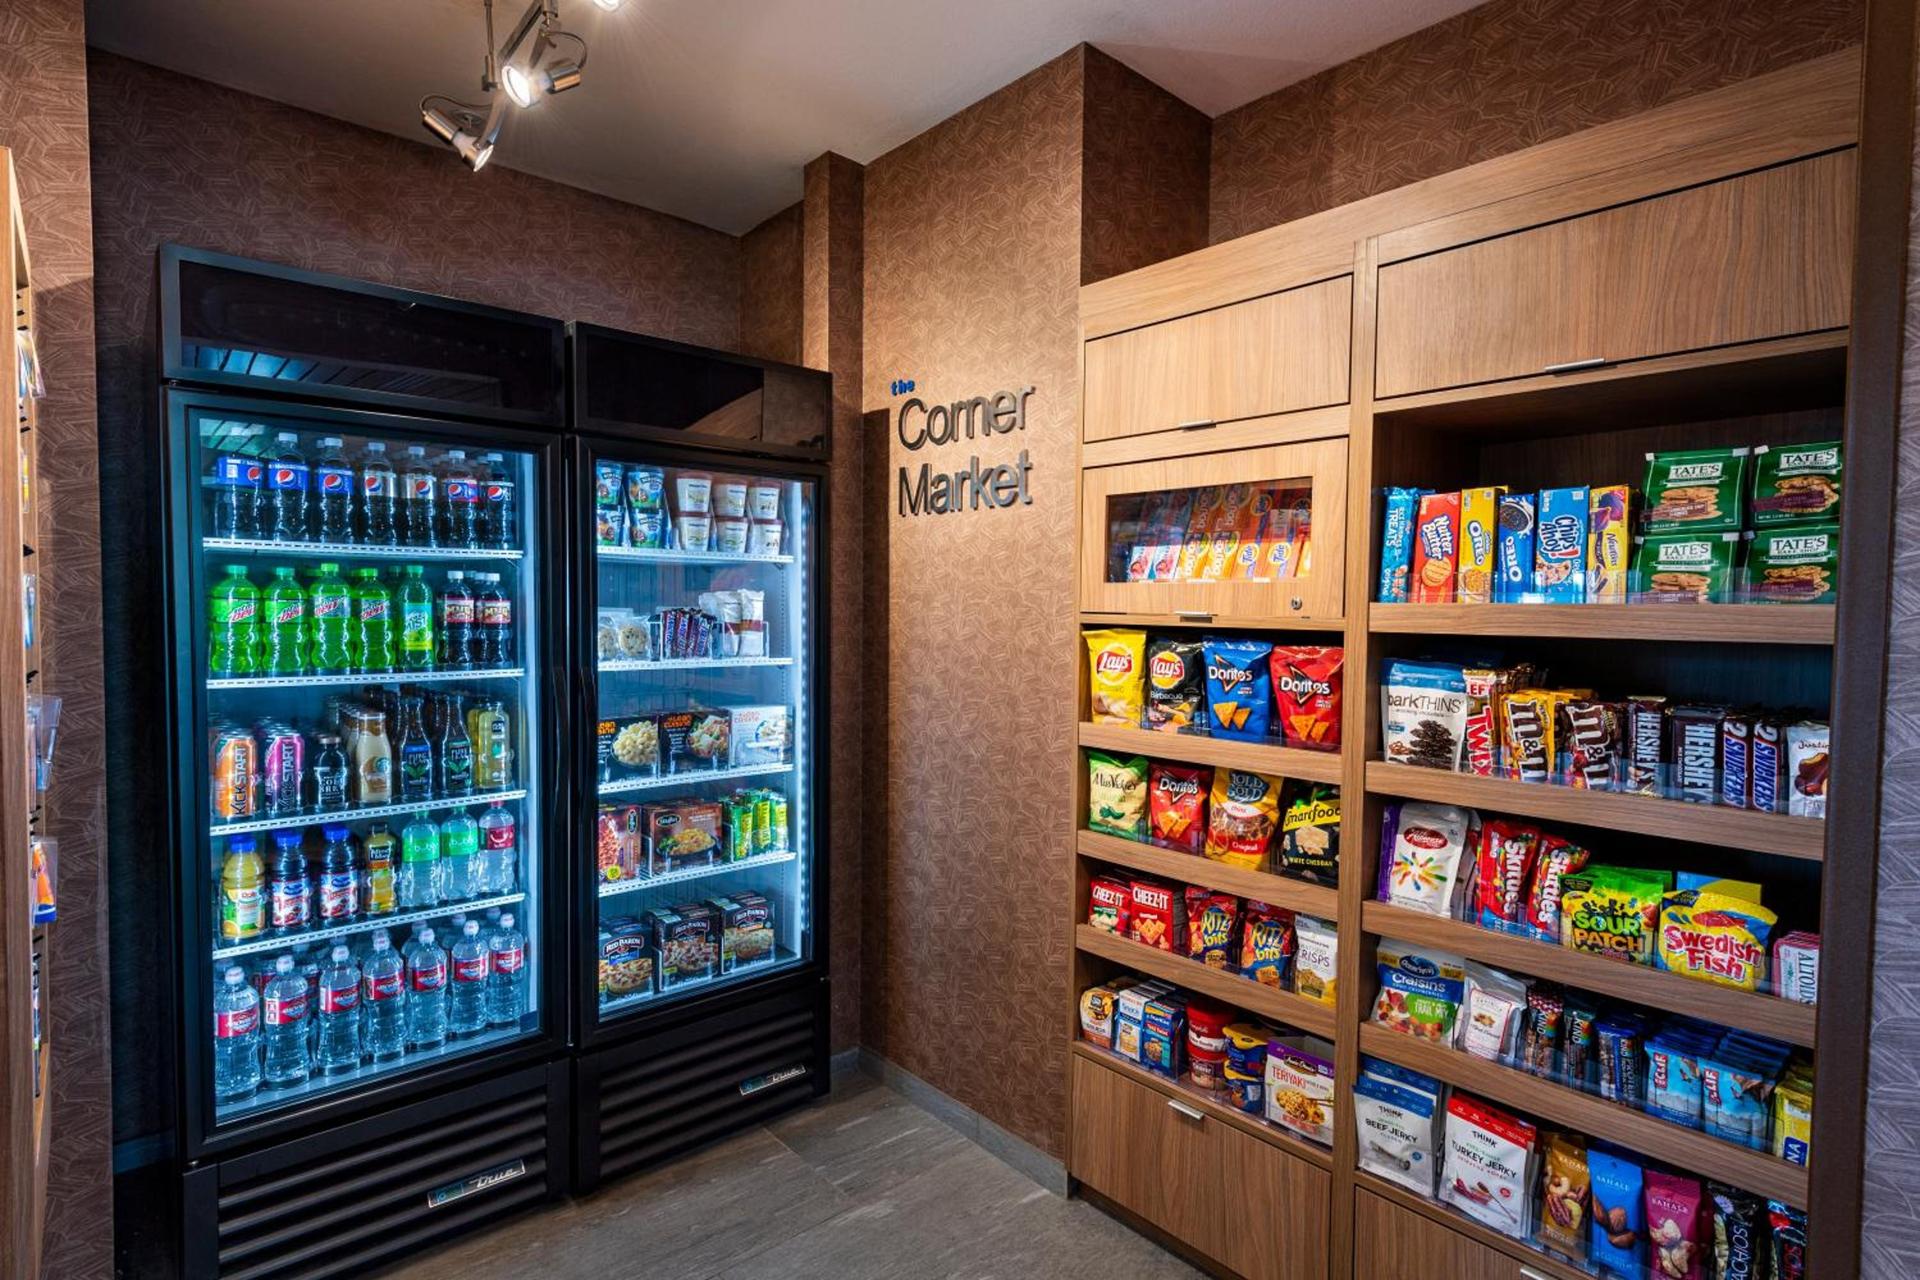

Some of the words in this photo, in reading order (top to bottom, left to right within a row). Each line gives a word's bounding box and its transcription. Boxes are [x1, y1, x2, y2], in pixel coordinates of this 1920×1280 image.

[891, 379, 915, 396] the
[898, 386, 1036, 451] Corner
[1672, 464, 1719, 475] TATE'S
[1784, 450, 1834, 465] TATE'S
[898, 449, 1033, 517] Market
[1386, 507, 1399, 548] TREATS
[1434, 515, 1453, 555] Nutter
[1555, 515, 1577, 556] Chips
[1273, 544, 1285, 562] Tide
[1421, 522, 1443, 560] Butter
[1468, 520, 1486, 566] OREO
[1662, 543, 1709, 556] TATE'S
[1772, 537, 1826, 550] TATE'S
[1241, 545, 1253, 563] Tide
[1505, 536, 1522, 583] OREO
[1208, 664, 1253, 682] Doritos
[1281, 675, 1331, 695] Doritos
[1467, 705, 1494, 777] TWIX
[1636, 712, 1660, 781] HERSHEY'S
[1724, 737, 1746, 807] SNICKERS
[1753, 741, 1777, 812] SNICKERS
[1159, 777, 1199, 794] Doritos
[1232, 841, 1258, 852] Original
[1503, 840, 1526, 914] Skittles
[1093, 885, 1124, 906] CHEEZ-IT
[1133, 886, 1169, 910] CHEEZ-IT
[1202, 911, 1231, 934] RITZ
[1574, 909, 1641, 937] SOUR
[1253, 923, 1284, 949] RITZ
[1573, 928, 1644, 953] PATCH
[1664, 925, 1761, 968] Swedish
[1299, 949, 1330, 967] RISPS
[1686, 946, 1745, 981] Fish
[1391, 973, 1446, 993] Craisins
[1797, 951, 1816, 1005] ALTOIDS
[1571, 1017, 1584, 1044] KIND
[1272, 1066, 1307, 1088] TERIYAKI
[1365, 1118, 1389, 1132] BEEF
[1390, 1126, 1419, 1144] JERKY
[1472, 1130, 1498, 1148] THINK
[1451, 1139, 1485, 1164] TURKEY
[1485, 1158, 1518, 1179] JERKY
[1558, 1155, 1590, 1174] SAHAL
[1785, 1143, 1801, 1163] NA
[470, 1166, 520, 1188] True
[1731, 1224, 1750, 1280] ACHIOS
